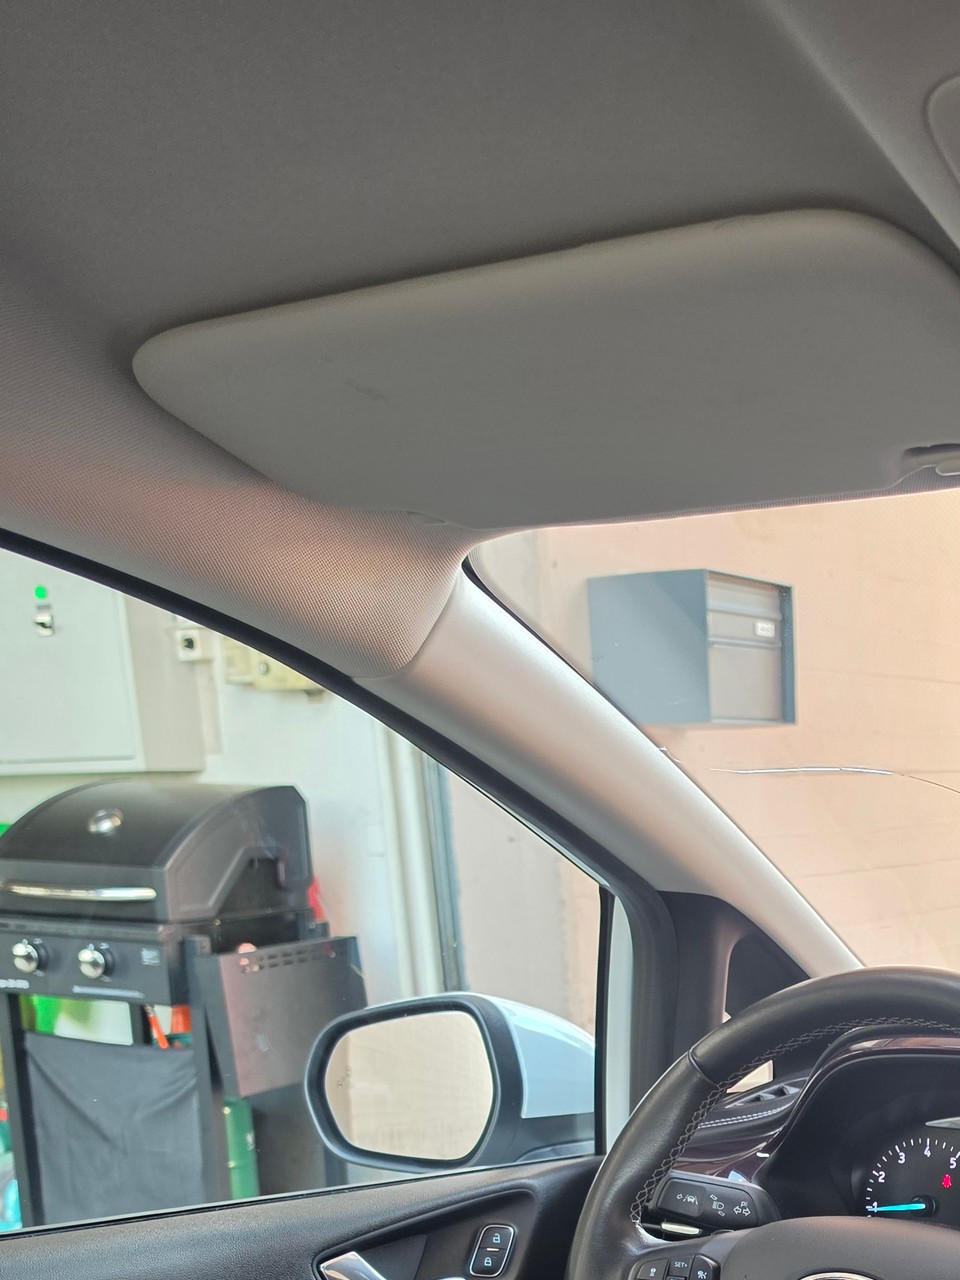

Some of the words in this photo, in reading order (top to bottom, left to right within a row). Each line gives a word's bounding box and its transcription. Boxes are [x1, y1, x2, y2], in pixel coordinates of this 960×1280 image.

[923, 1146, 931, 1157] 4
[898, 1153, 906, 1164] 3
[949, 1158, 957, 1168] 5
[878, 1172, 886, 1182] 2
